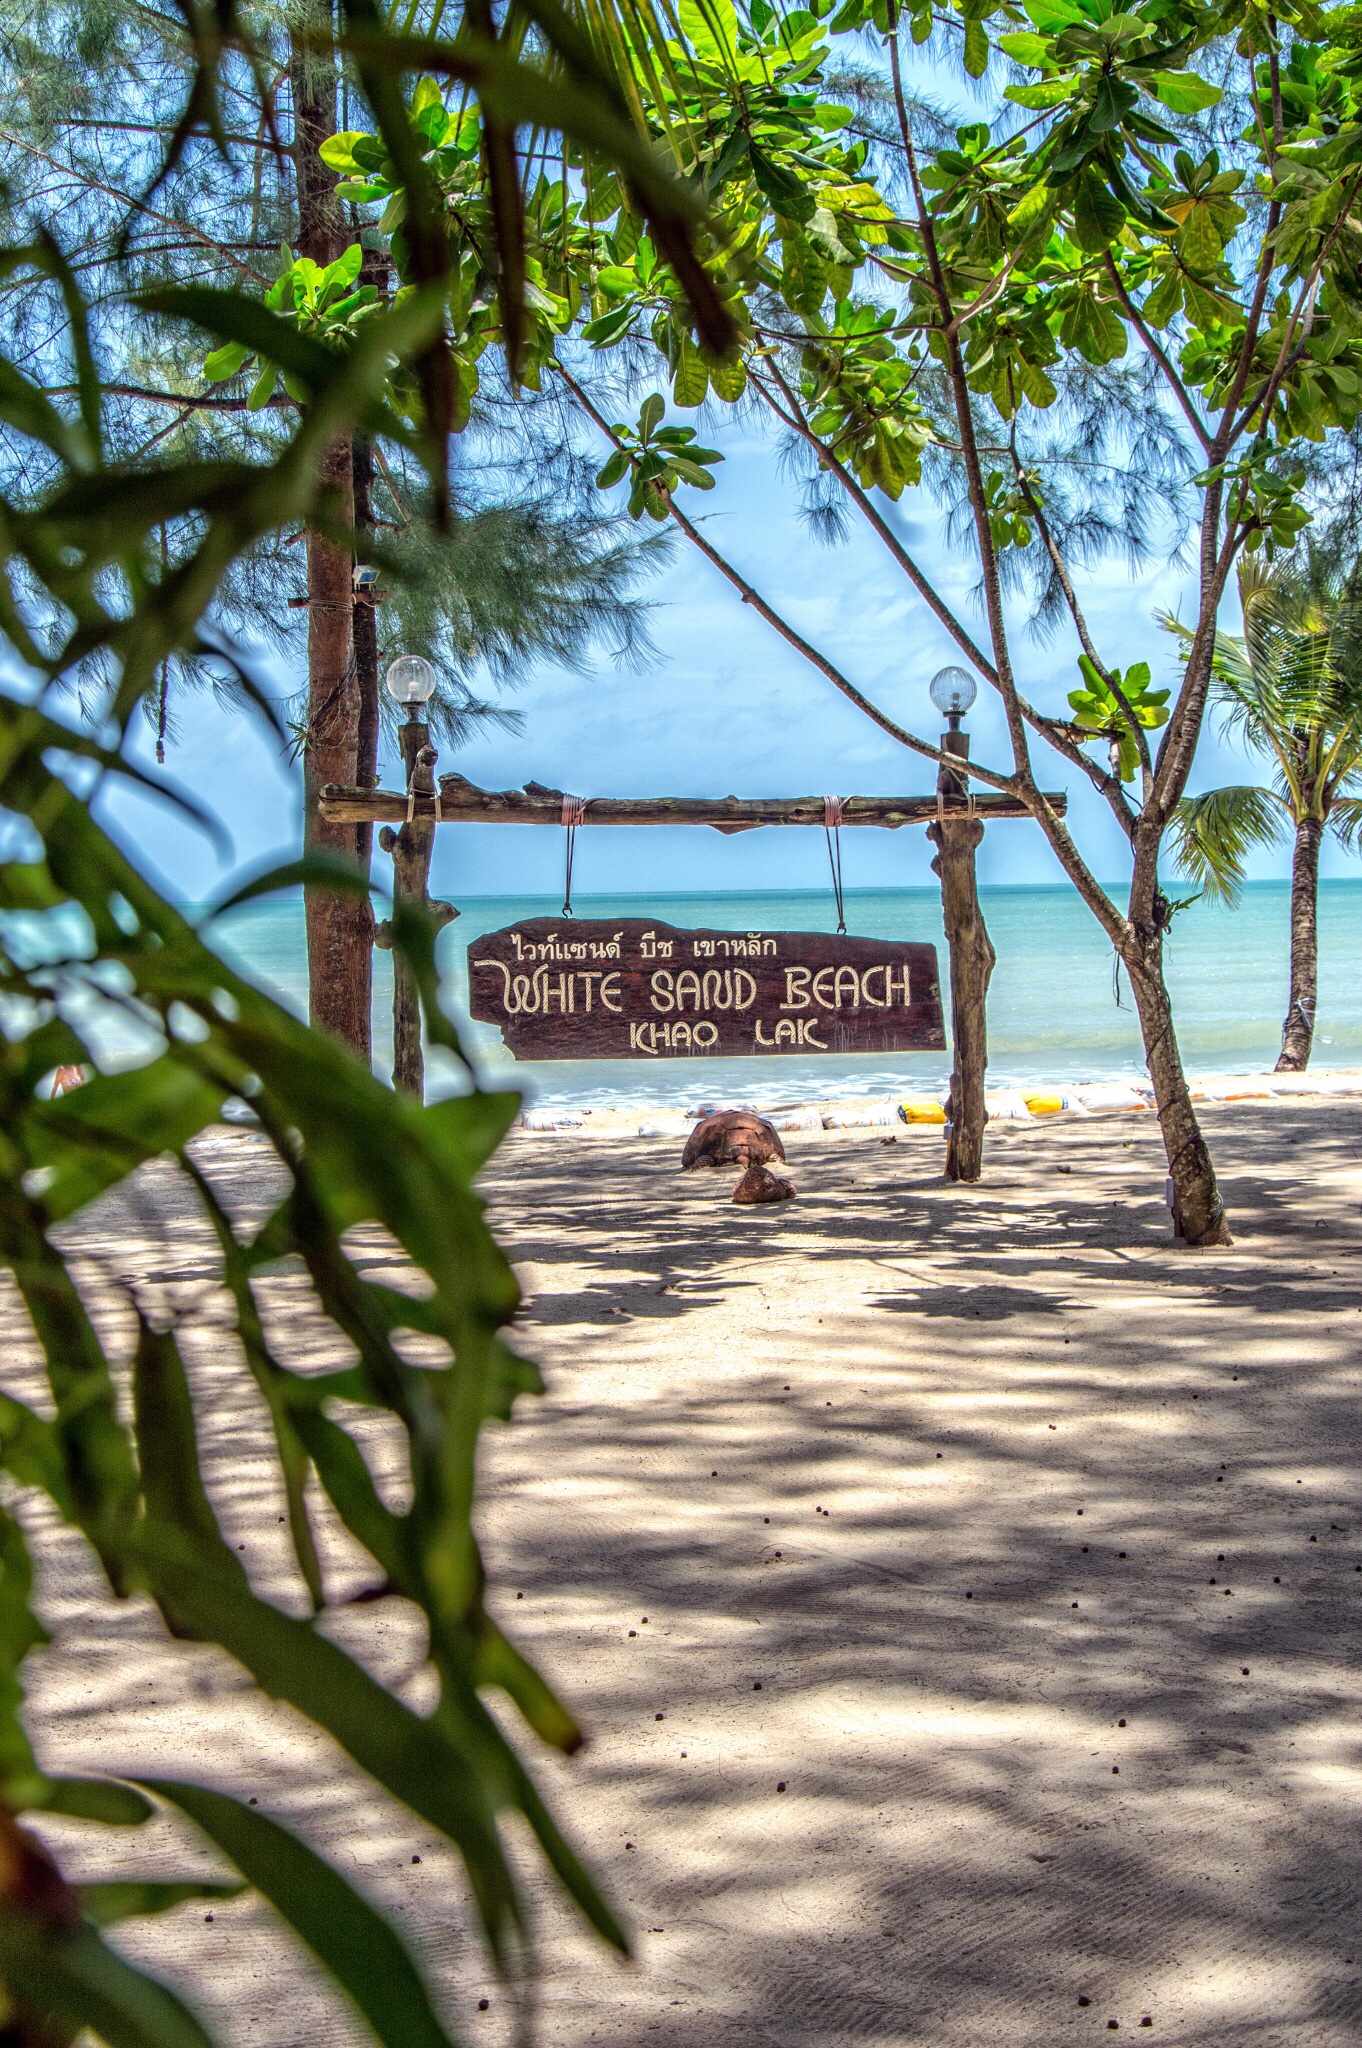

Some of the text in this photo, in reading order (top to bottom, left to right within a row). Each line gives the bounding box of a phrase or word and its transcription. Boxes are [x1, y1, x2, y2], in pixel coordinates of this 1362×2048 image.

[640, 930, 673, 959] บีช
[693, 932, 778, 958] เขาหลัก
[474, 959, 912, 1014] WHITE SAND BEACH
[630, 1018, 829, 1055] KHAO LAK
